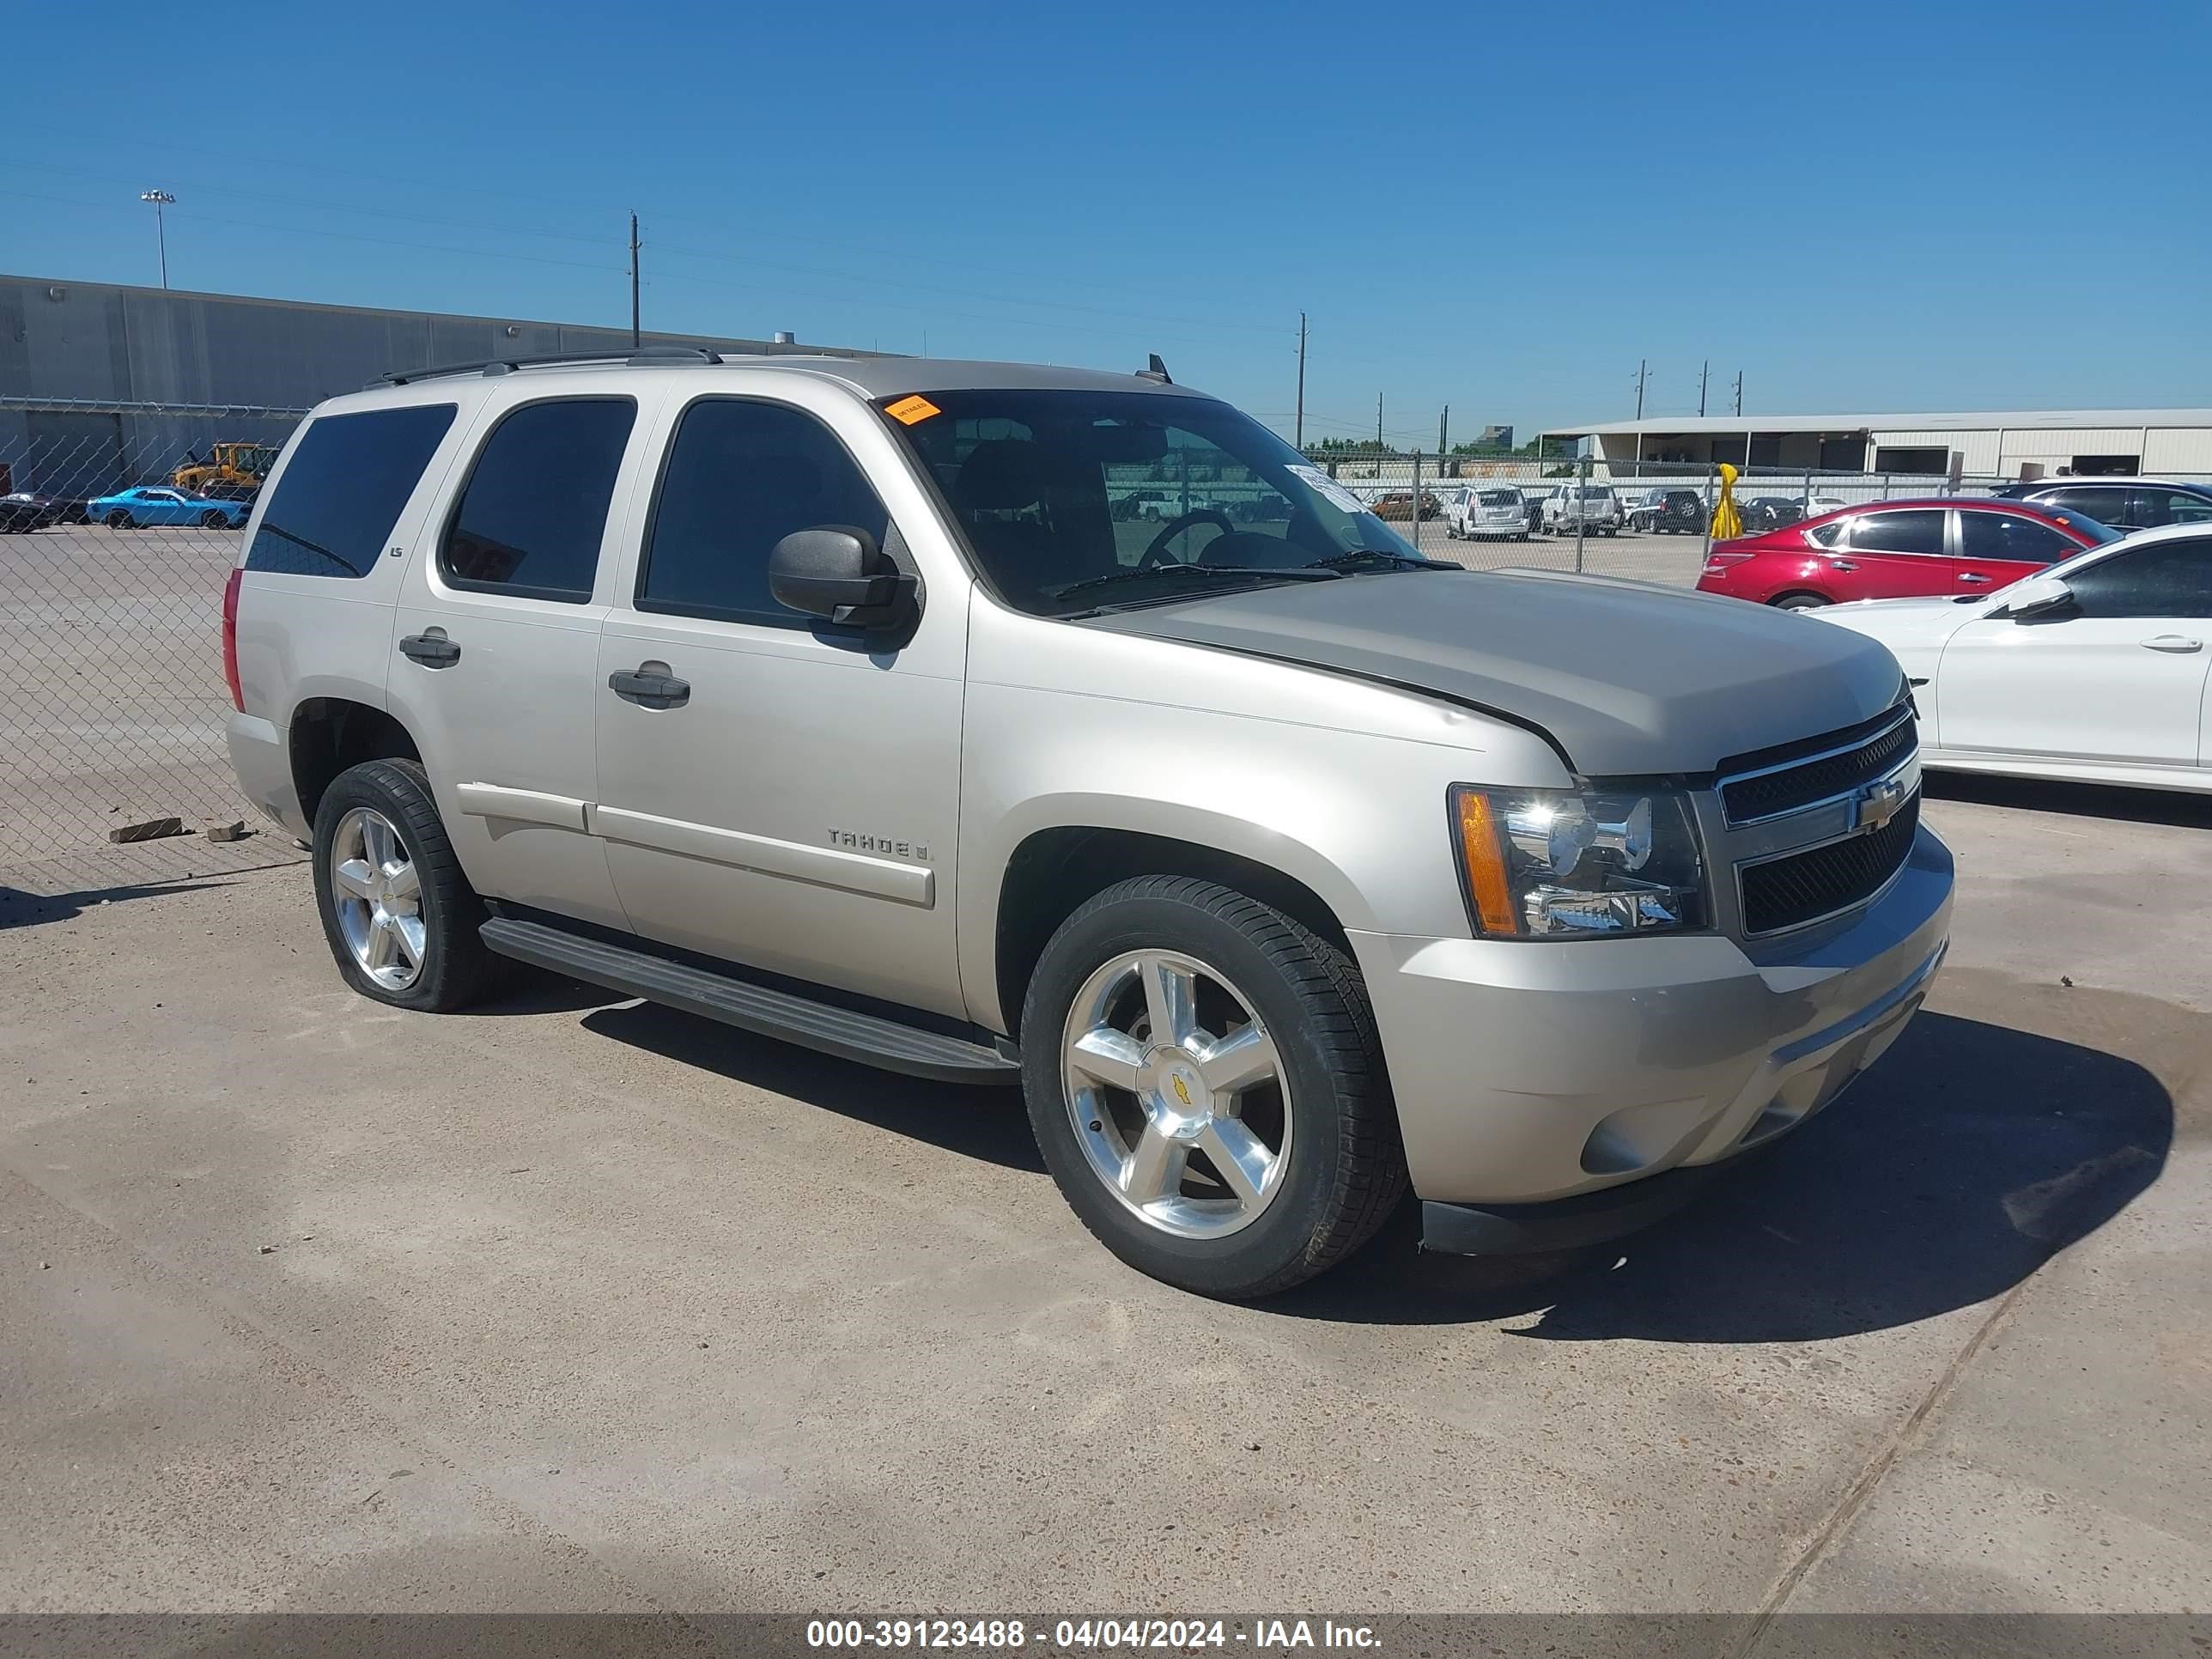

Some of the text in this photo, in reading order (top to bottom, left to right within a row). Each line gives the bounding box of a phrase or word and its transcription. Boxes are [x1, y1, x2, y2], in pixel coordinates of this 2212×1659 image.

[898, 403, 927, 417] DETAILED
[391, 547, 404, 557] LS
[828, 829, 909, 857] TAHOE
